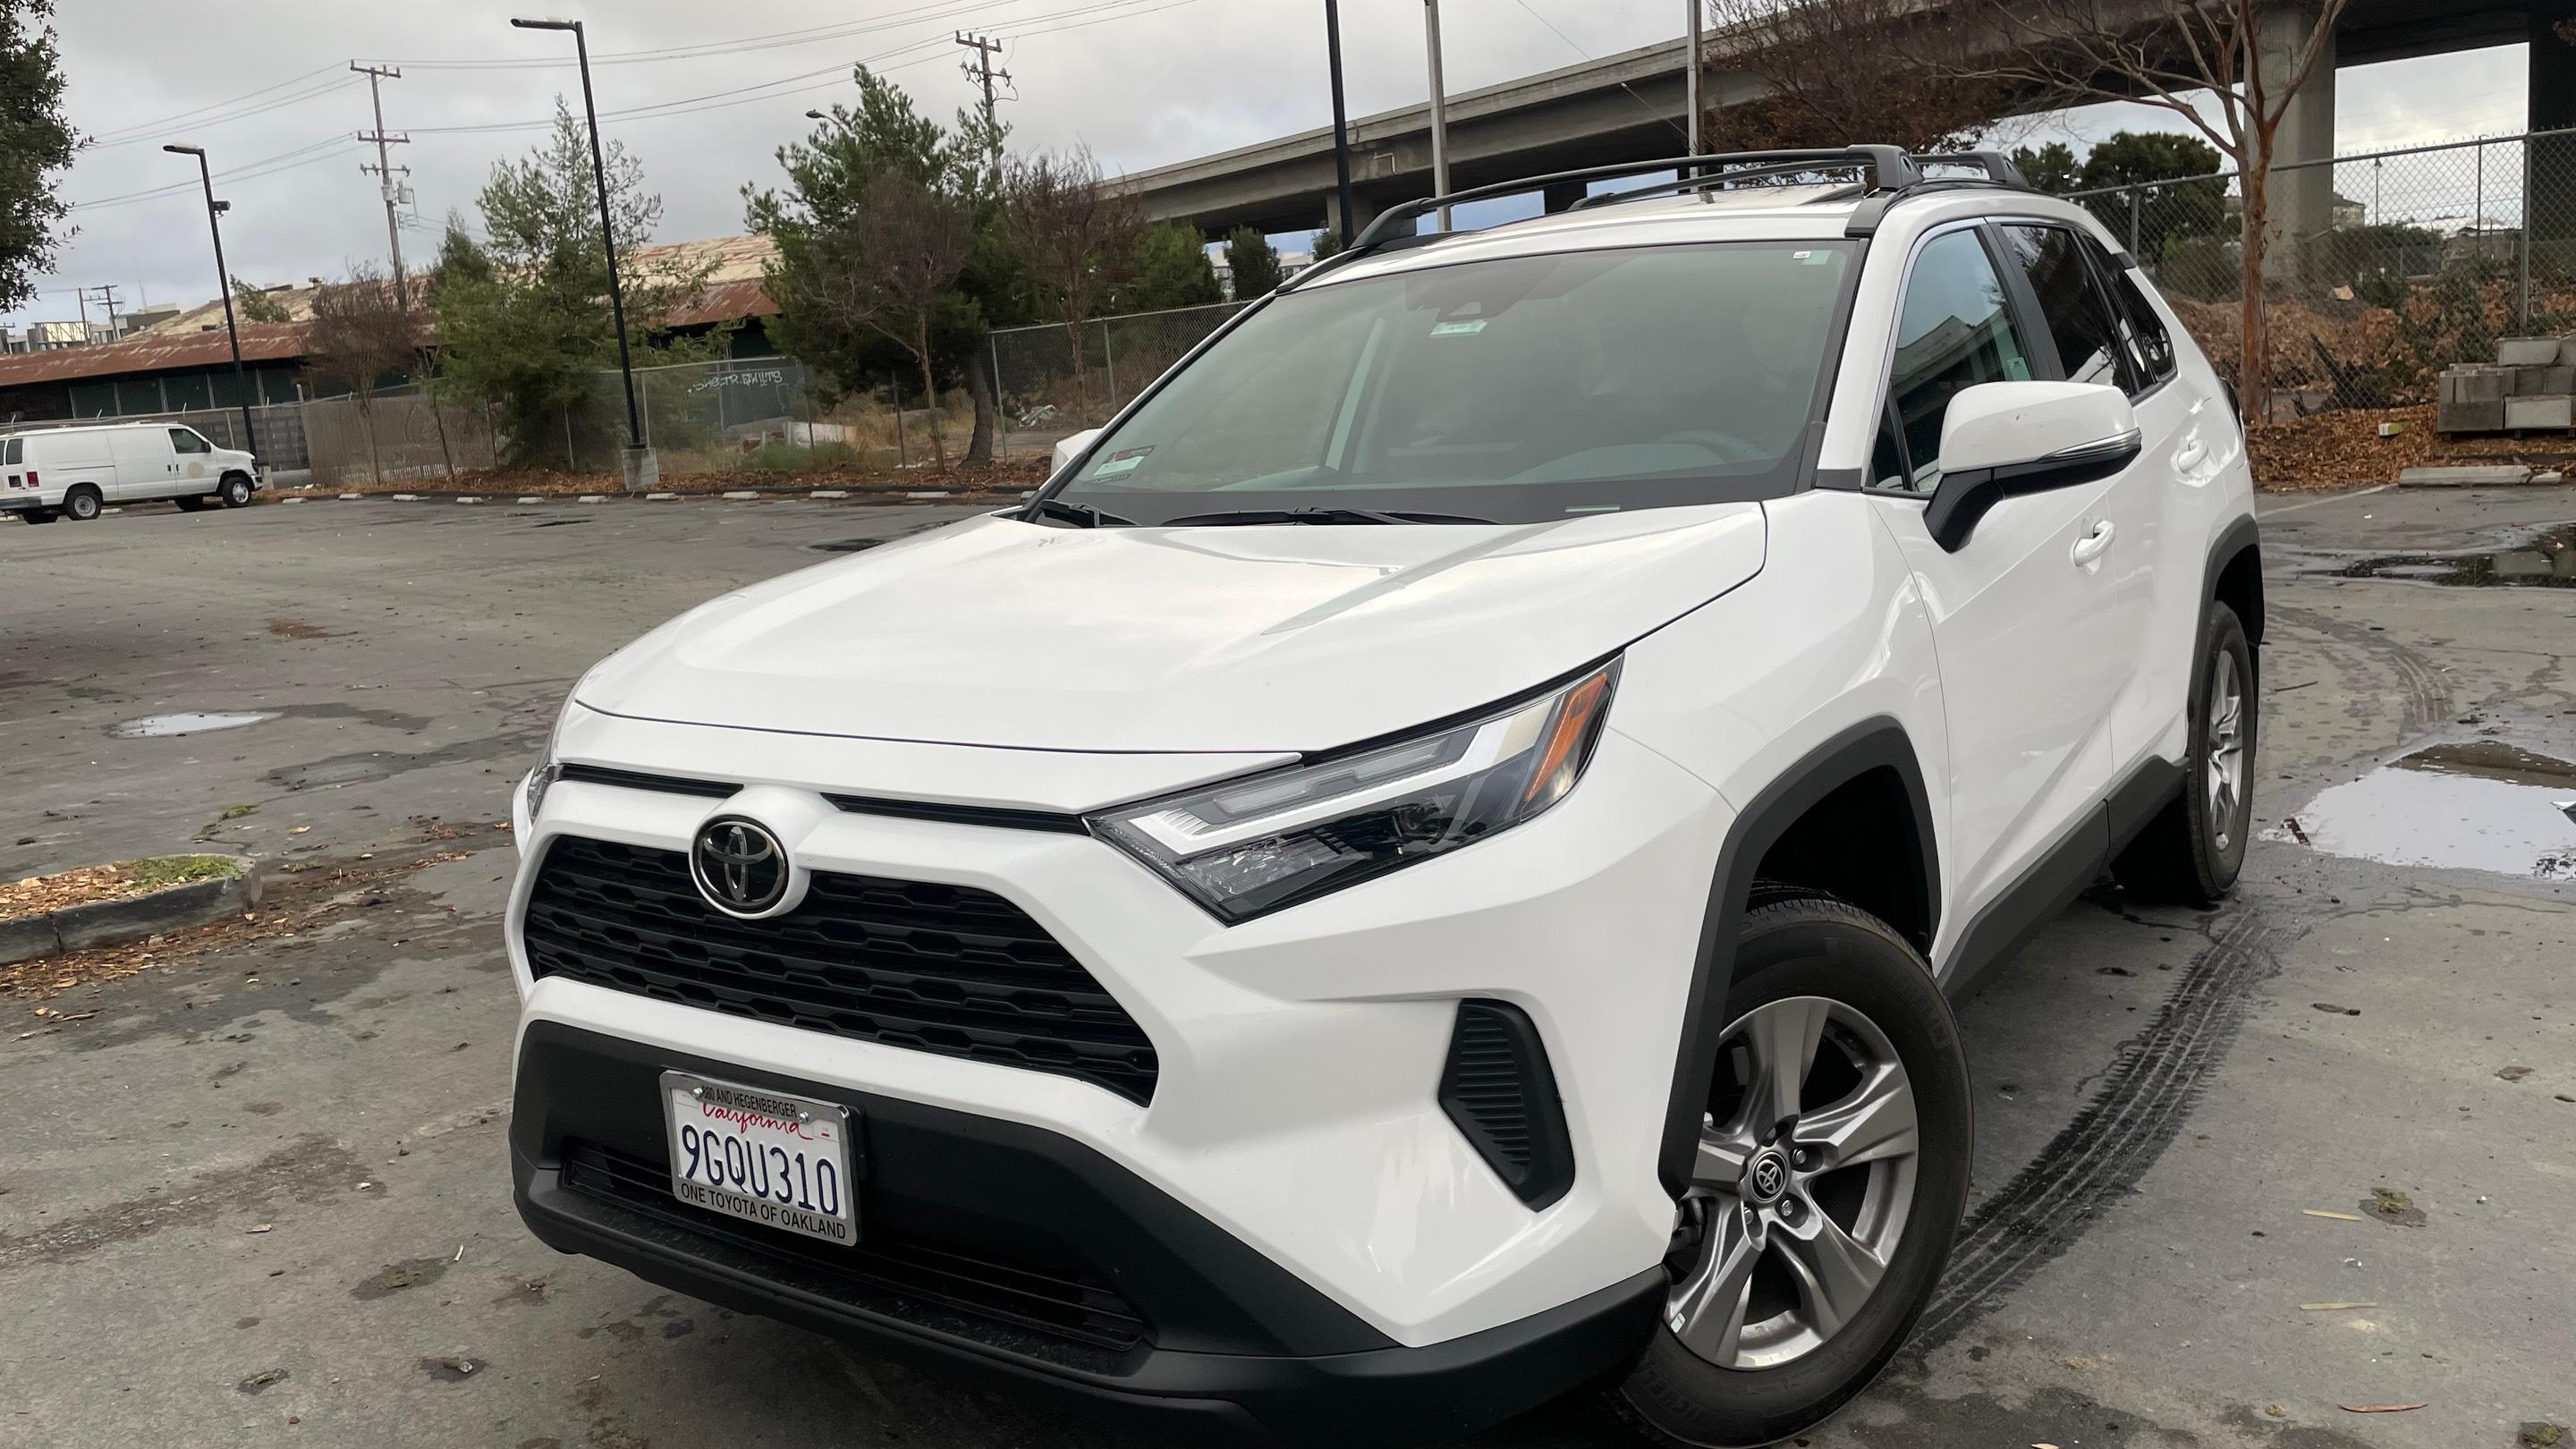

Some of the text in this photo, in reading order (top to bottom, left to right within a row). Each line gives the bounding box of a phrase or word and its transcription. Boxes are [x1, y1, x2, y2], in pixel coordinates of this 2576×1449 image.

[716, 1089, 733, 1105] AND
[734, 1092, 797, 1117] HEGENBERGER
[682, 1124, 839, 1216] 9GQU310
[681, 1182, 846, 1239] ONE TOYOTA OF OAKLAND
